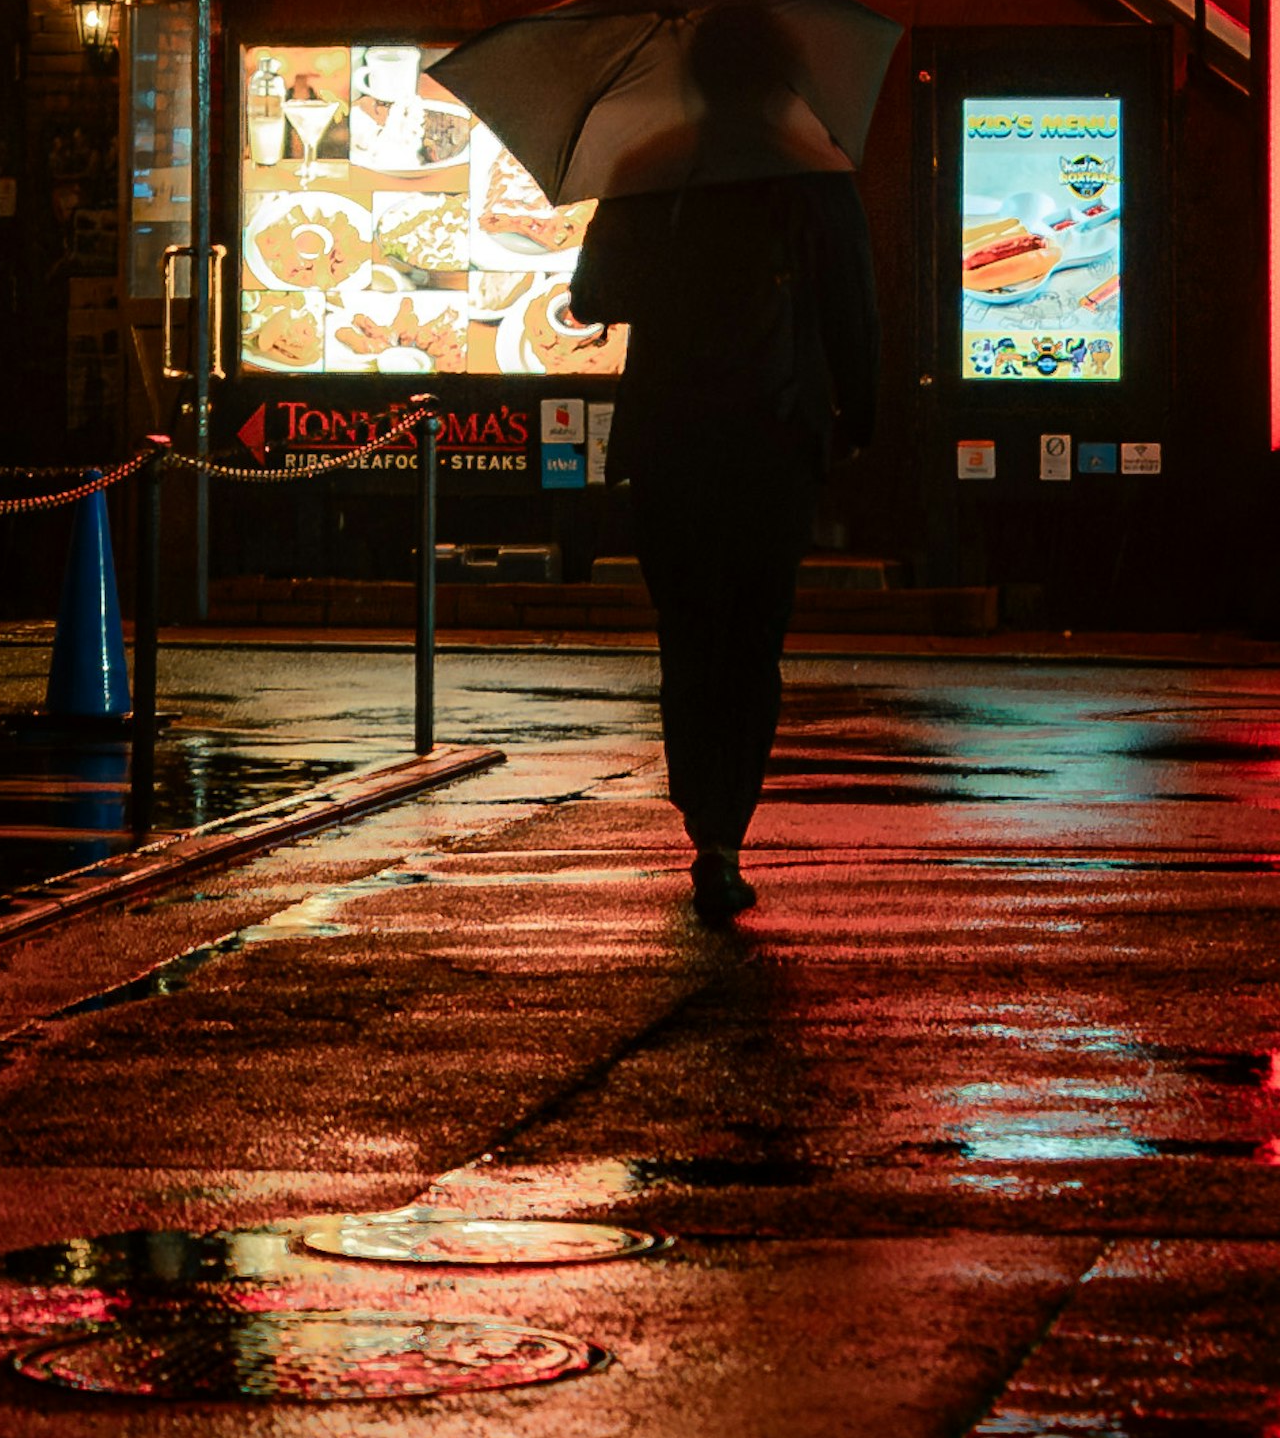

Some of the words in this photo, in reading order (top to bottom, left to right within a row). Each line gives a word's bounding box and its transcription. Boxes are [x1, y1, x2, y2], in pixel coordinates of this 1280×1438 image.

[968, 115, 1033, 138] KID'S
[1040, 116, 1117, 138] MENU
[277, 401, 381, 442] TONY
[451, 454, 528, 471] STEAKS
